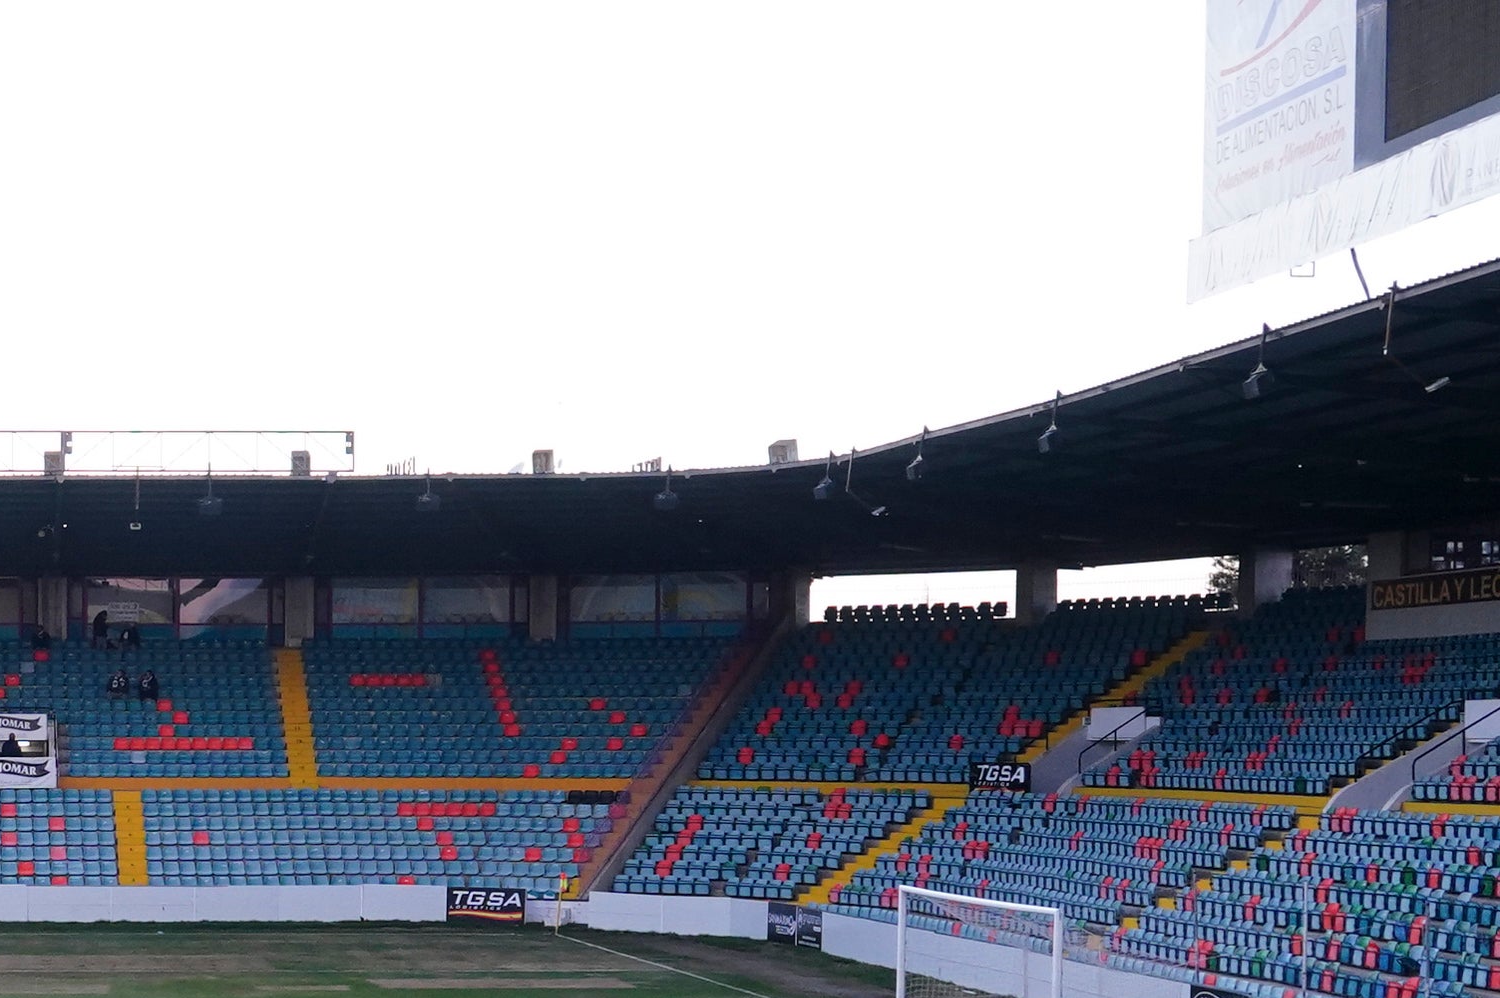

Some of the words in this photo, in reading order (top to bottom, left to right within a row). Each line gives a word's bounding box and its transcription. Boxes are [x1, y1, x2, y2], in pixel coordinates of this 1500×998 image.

[1215, 25, 1347, 122] DISCOSA
[1216, 136, 1230, 165] DE
[1323, 84, 1346, 115] S.L.
[1373, 580, 1450, 608] CASTILLA
[1454, 578, 1465, 601] Y
[976, 764, 1025, 783] TGSA
[452, 890, 522, 908] TGSA
